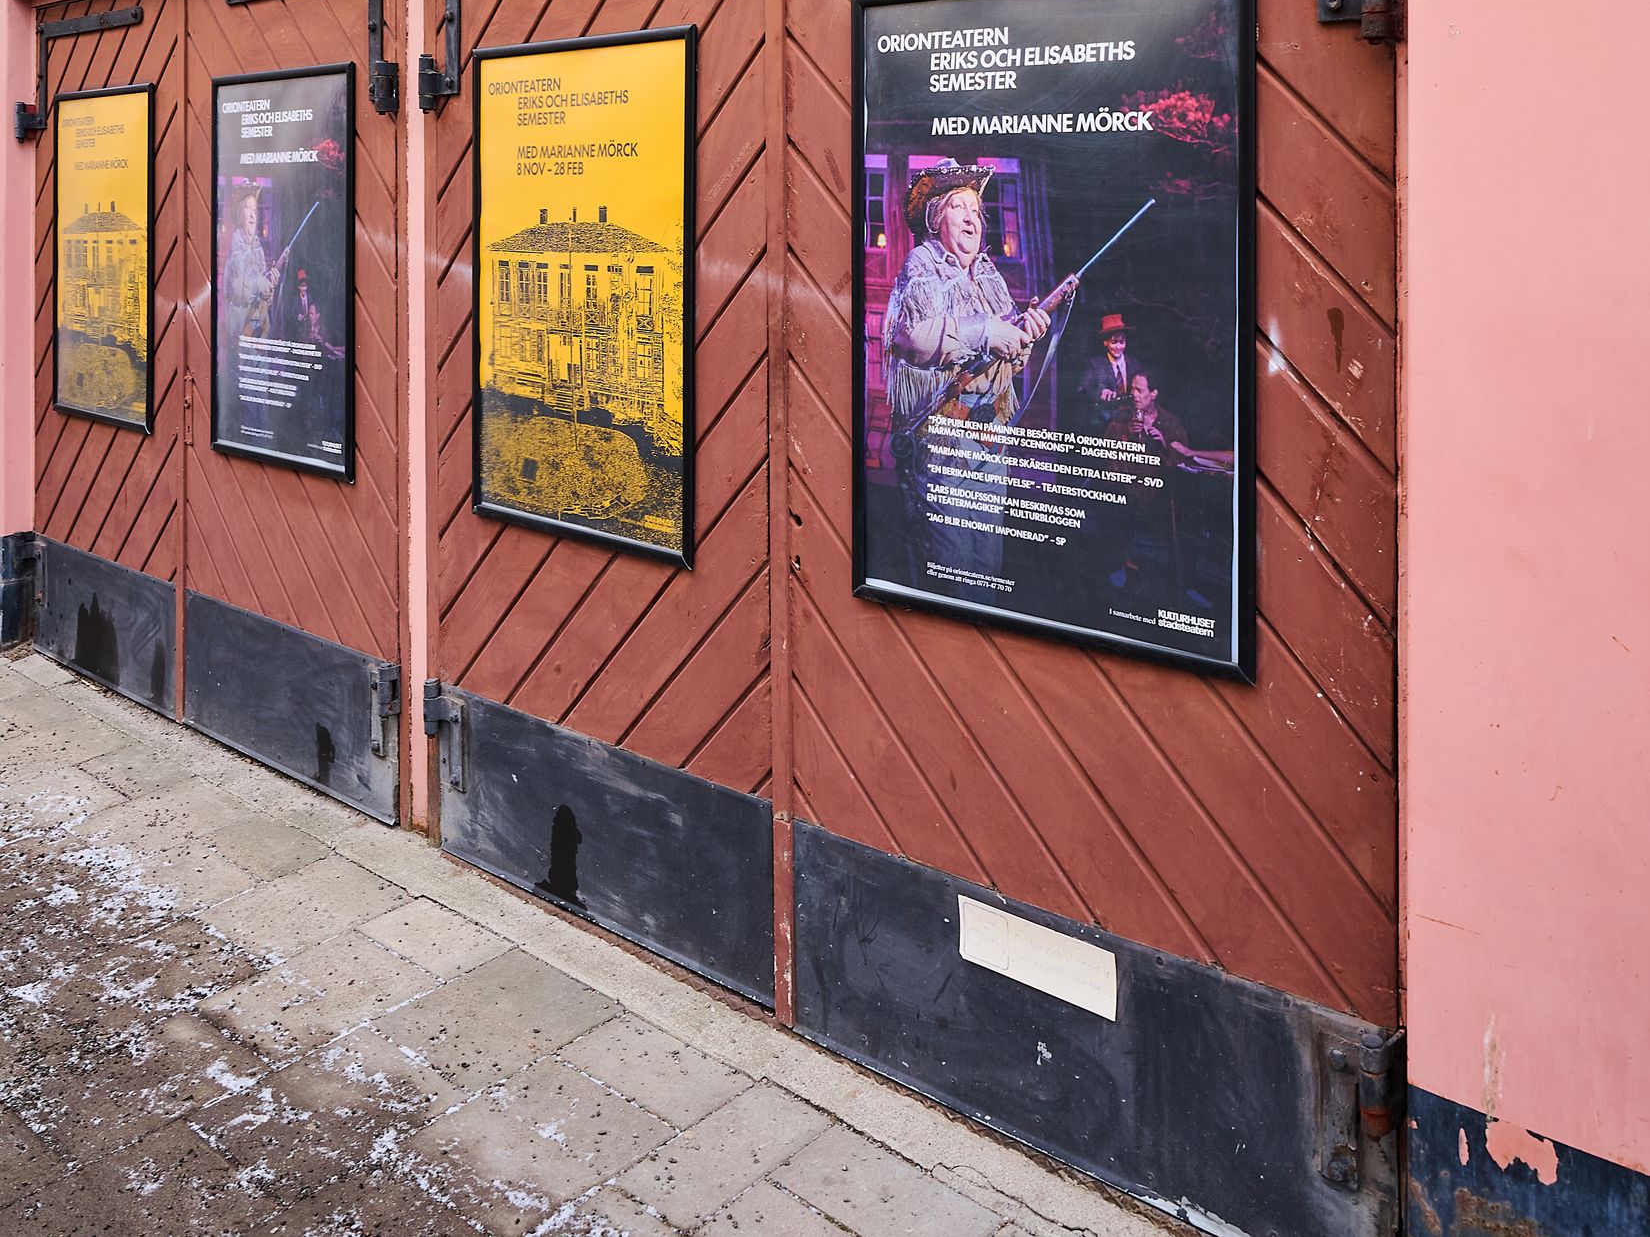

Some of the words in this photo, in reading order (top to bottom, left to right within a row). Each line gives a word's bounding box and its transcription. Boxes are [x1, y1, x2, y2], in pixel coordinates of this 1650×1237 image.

[878, 27, 1008, 54] ORIONTEATERN
[930, 51, 978, 71] ERIKS
[980, 49, 1020, 69] OCH
[1024, 41, 1136, 66] ELISABETHS
[488, 78, 561, 95] ORIONTEATERN
[930, 71, 1016, 93] SEMESTER
[518, 94, 544, 110] ERIKS
[546, 94, 568, 108] OCH
[570, 89, 629, 107] ELISABETHS
[517, 111, 566, 126] SEMESTER
[932, 116, 970, 136] MED
[972, 112, 1073, 135] MARIANNE
[1076, 106, 1154, 132] MÖRCK
[517, 146, 538, 159] MED
[540, 144, 595, 158] MARIANNE
[598, 140, 638, 157] MÖRCK
[517, 164, 522, 176] 8
[524, 163, 545, 175] NOV
[554, 162, 565, 175] 28
[567, 162, 584, 174] FEB
[928, 425, 965, 438] NÄRMAST
[966, 432, 980, 440] OM
[981, 434, 1020, 446] IMMERSIV
[1081, 448, 1117, 460] DAGENS
[1119, 453, 1161, 466] NYHETER
[948, 418, 982, 430] PUBLIKEN
[984, 423, 1026, 437] PÅMINNER
[1027, 428, 1064, 441] BESÖKET
[1065, 433, 1076, 443] PÅ
[1077, 436, 1145, 452] ORIONTEATERN
[972, 451, 1001, 463] MÖRCK
[1002, 456, 1018, 467] GER
[1019, 458, 1071, 474] SKÄRSELDEN
[1073, 467, 1100, 479] EXTRA
[1144, 477, 1164, 488] SVD
[944, 466, 984, 481] BERIKANDE
[1042, 483, 1126, 504] TEATERSTOCKHOLM
[927, 493, 937, 502] EN
[1010, 508, 1081, 529] KULTURBLOGGEN
[950, 487, 1000, 504] RUDOLFSSON
[1001, 496, 1019, 507] KAN
[1020, 500, 1064, 515] BESKRIVAS
[1065, 508, 1085, 519] SOM
[944, 516, 960, 526] BLIR
[961, 519, 994, 533] ENORMT
[1056, 537, 1066, 546] SP
[1158, 609, 1216, 629] KULTURHUSET
[1158, 620, 1214, 638] stadsteatern
